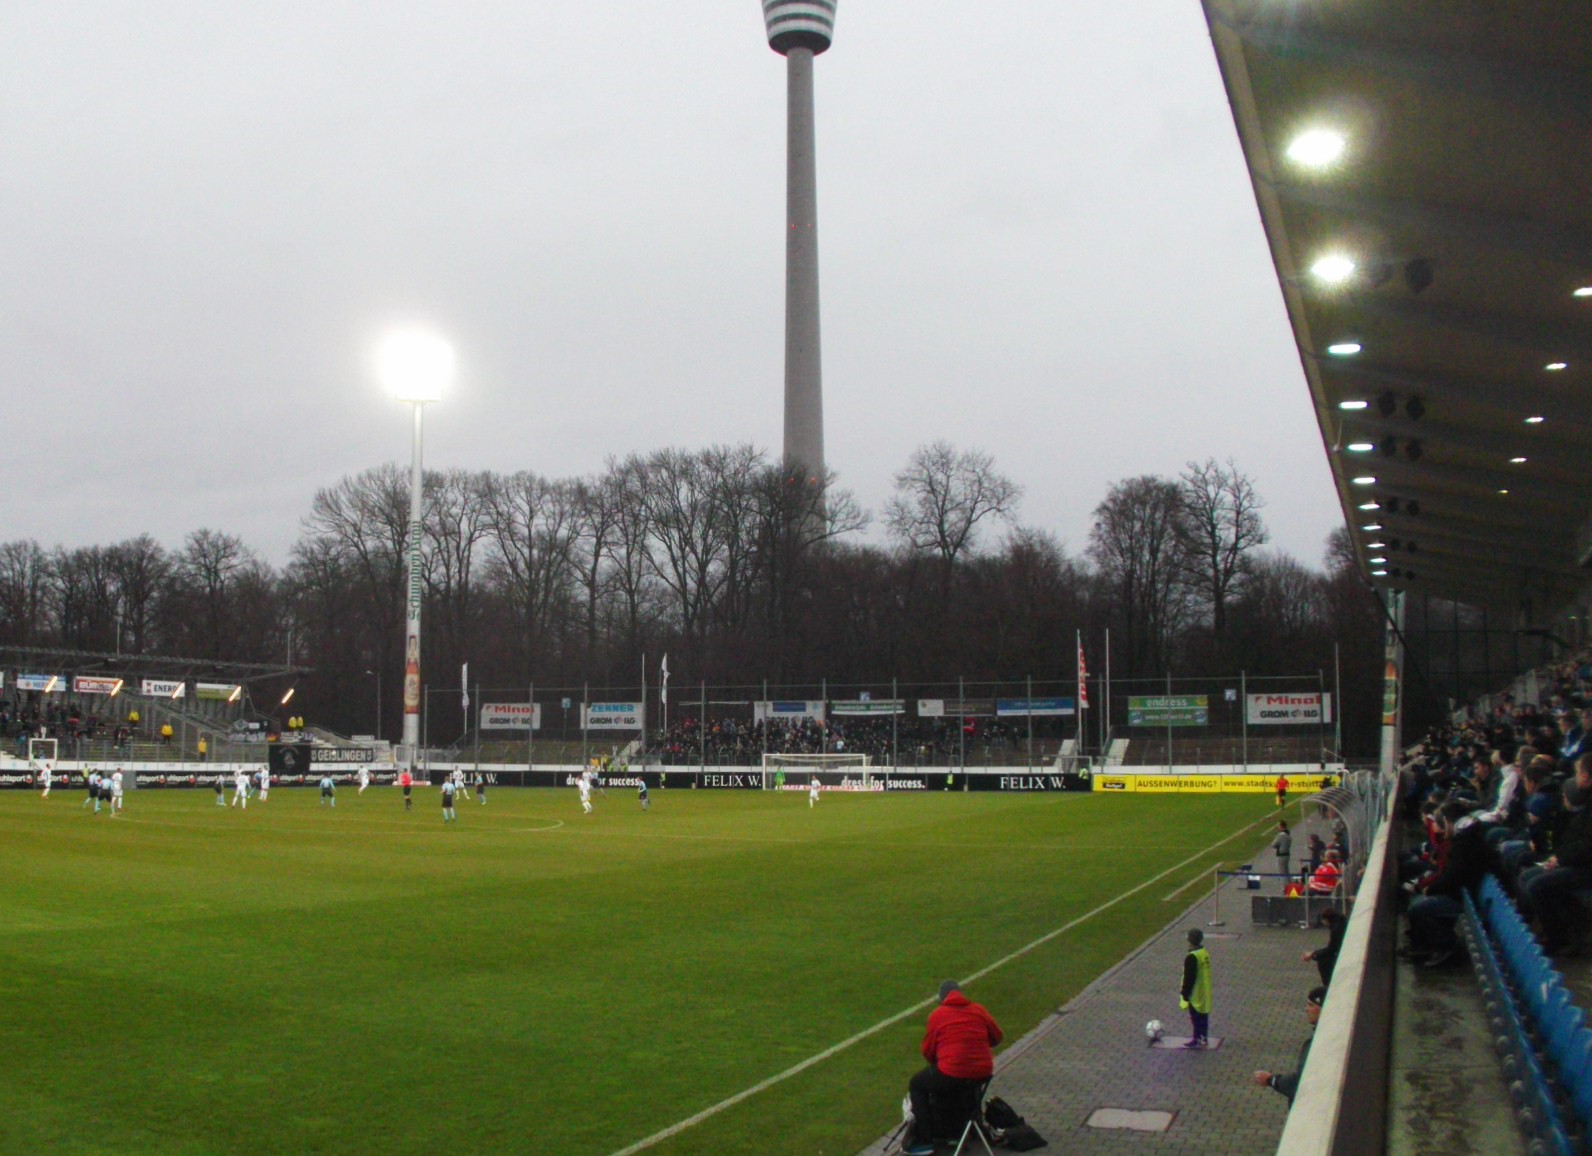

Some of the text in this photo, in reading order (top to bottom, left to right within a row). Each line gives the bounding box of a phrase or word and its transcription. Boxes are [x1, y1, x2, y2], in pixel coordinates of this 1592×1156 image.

[317, 749, 367, 762] GEISLINGEN
[703, 774, 762, 787] FELIX W.
[887, 778, 926, 789] success.
[1000, 776, 1067, 789] FELIX W.
